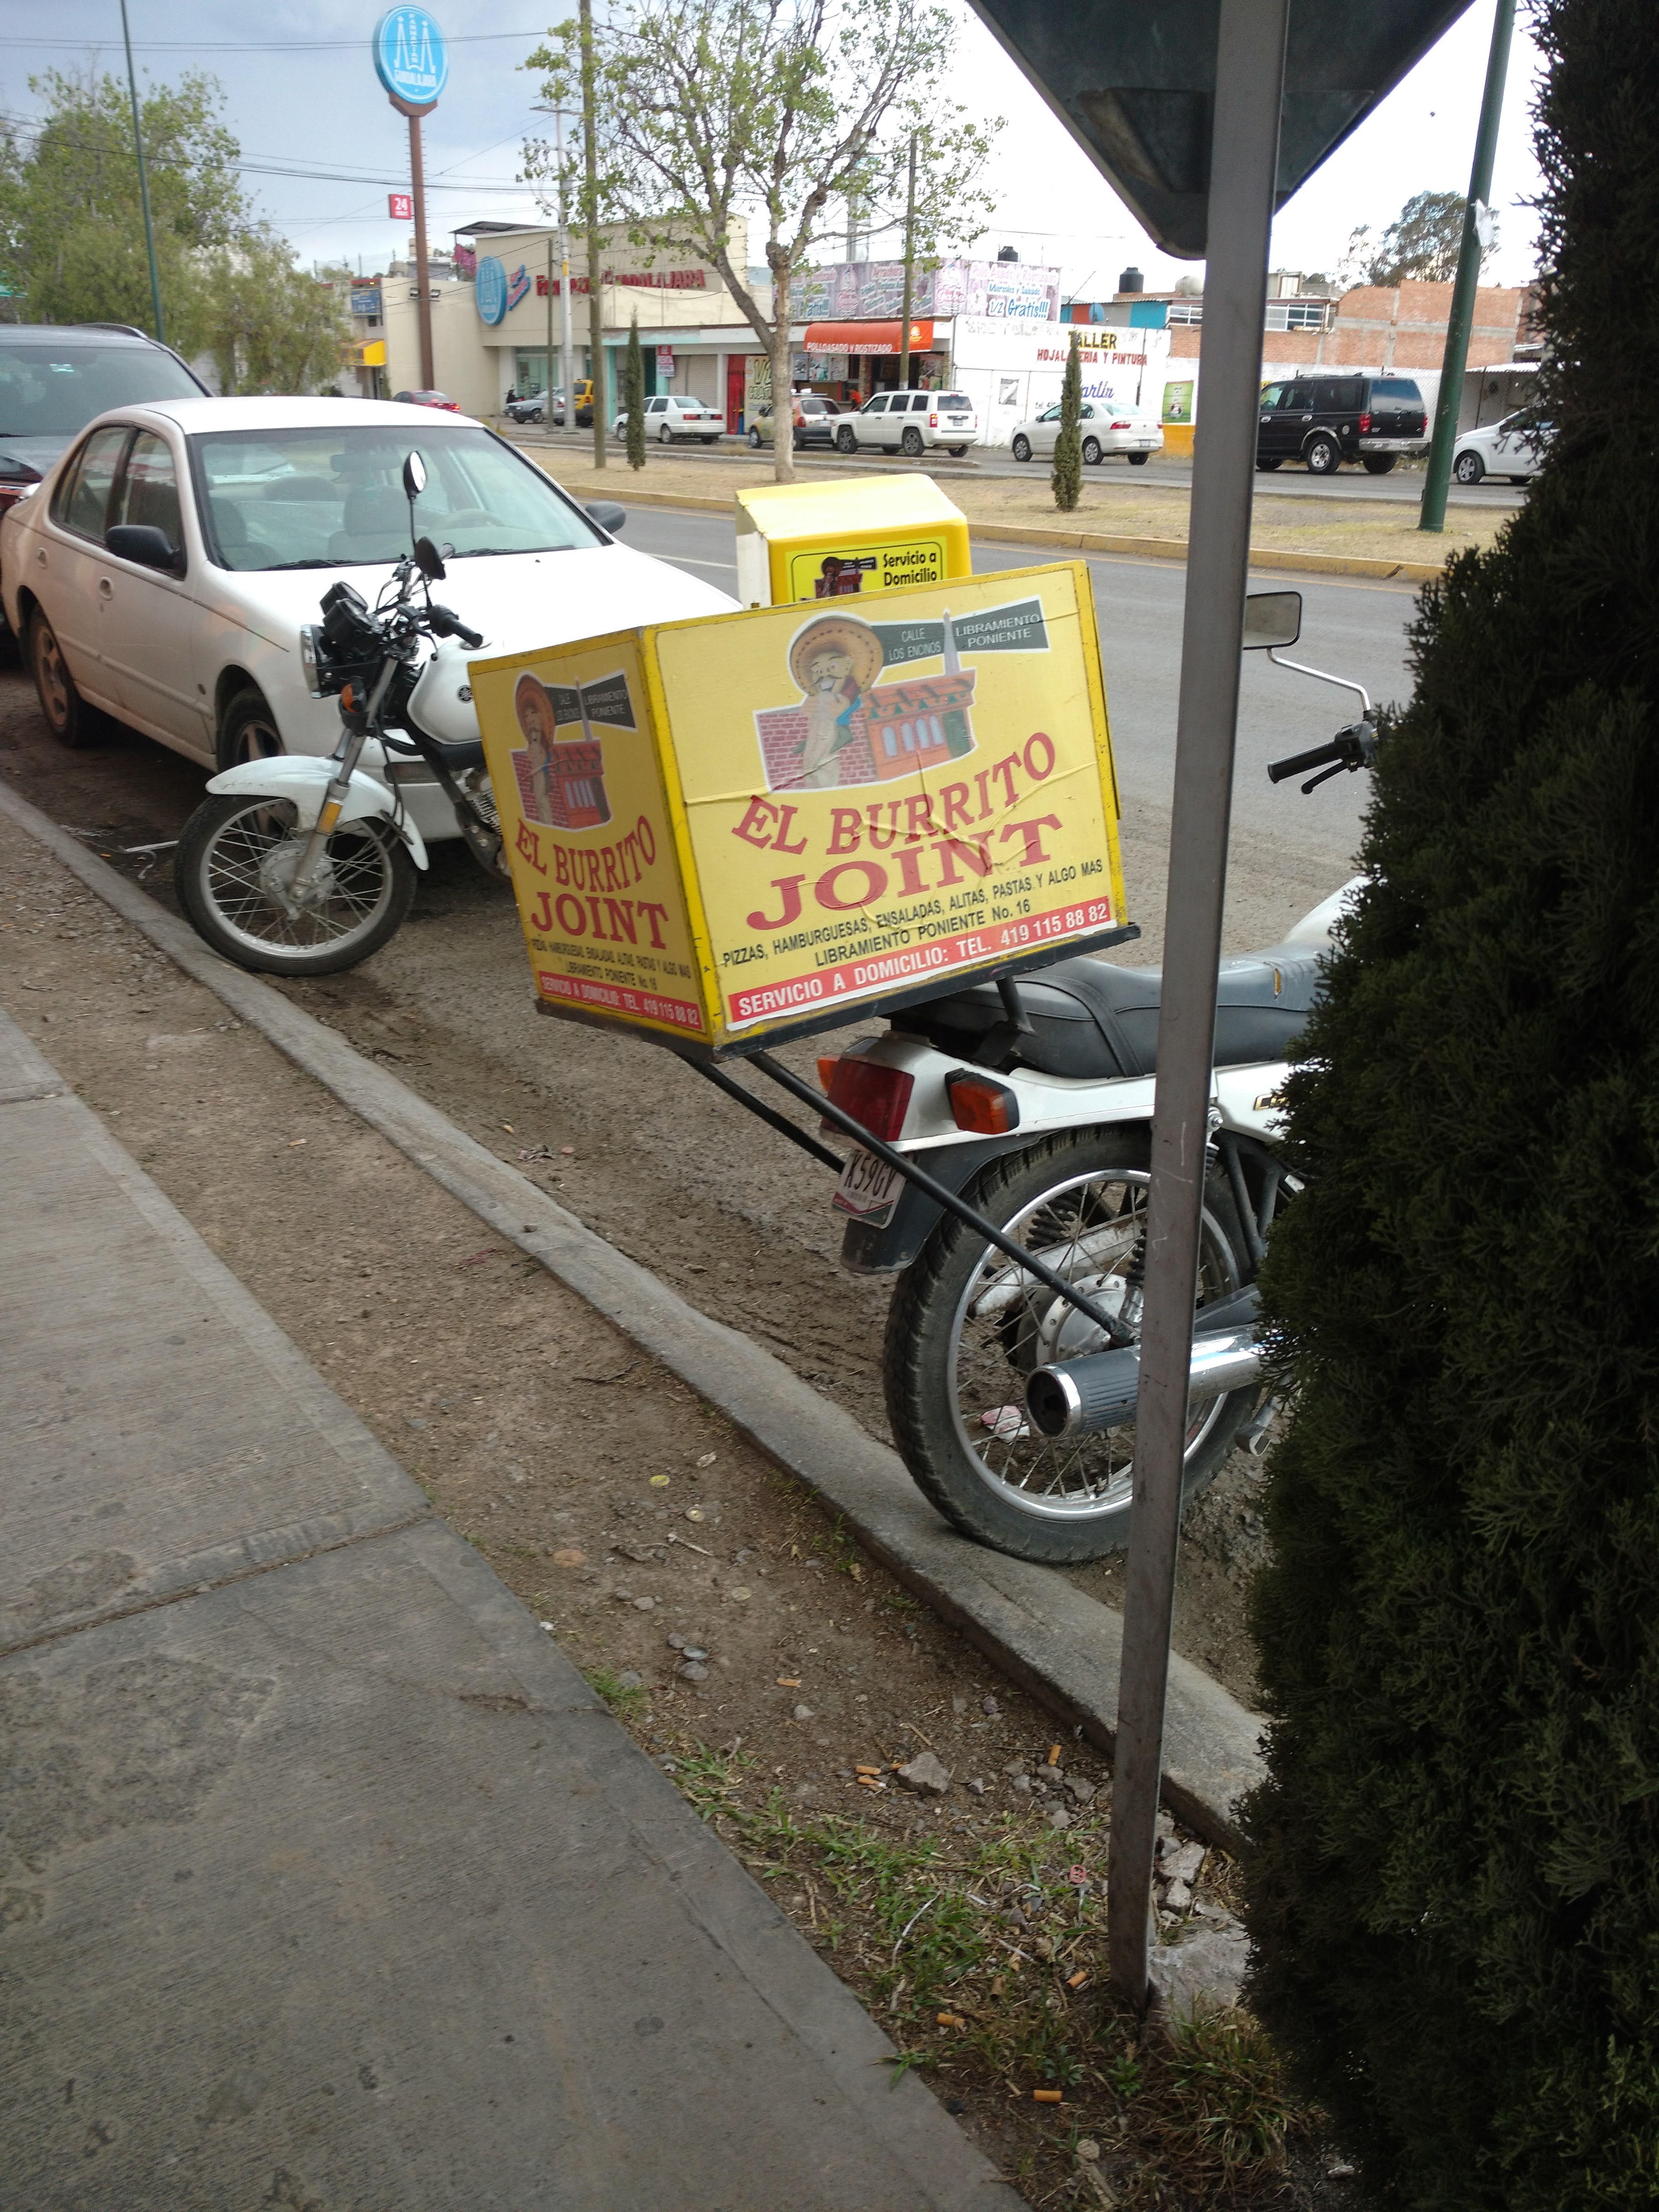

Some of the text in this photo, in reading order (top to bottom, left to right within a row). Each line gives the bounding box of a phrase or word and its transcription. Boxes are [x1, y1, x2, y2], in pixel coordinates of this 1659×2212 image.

[394, 197, 407, 211] 24
[990, 299, 1049, 318] 1/2 Gratis!!!
[854, 344, 893, 354] ROSTIZADO
[1037, 348, 1147, 365] HOJALAERIA Y PINTURA
[883, 550, 925, 568] Servicio
[930, 553, 936, 563] a
[884, 567, 937, 586] Domicilio
[955, 613, 1041, 637] LIBRAMIENTO
[901, 628, 925, 642] CALLE
[967, 628, 1032, 647] PONIENTE
[888, 647, 905, 661] LOS
[732, 732, 1056, 855] EL BURRITO
[516, 815, 655, 893] EL BURRITO
[746, 813, 1063, 930] JOINT
[531, 891, 669, 950] JOINT
[723, 943, 768, 967] PIZZAS,
[772, 917, 872, 955] HAMBURGUESAS,
[876, 899, 945, 929] ENSALADAS,
[950, 888, 988, 911] ALITAS,
[1035, 873, 1042, 888] Y
[1048, 865, 1076, 886] ALGO
[1081, 859, 1103, 877] MAS
[815, 898, 1030, 967] LIBRAMIENTO PONIENTE No. 16
[738, 902, 1107, 1016] SERVICIO A DOMICILIO: TEL. 419 115 88 82
